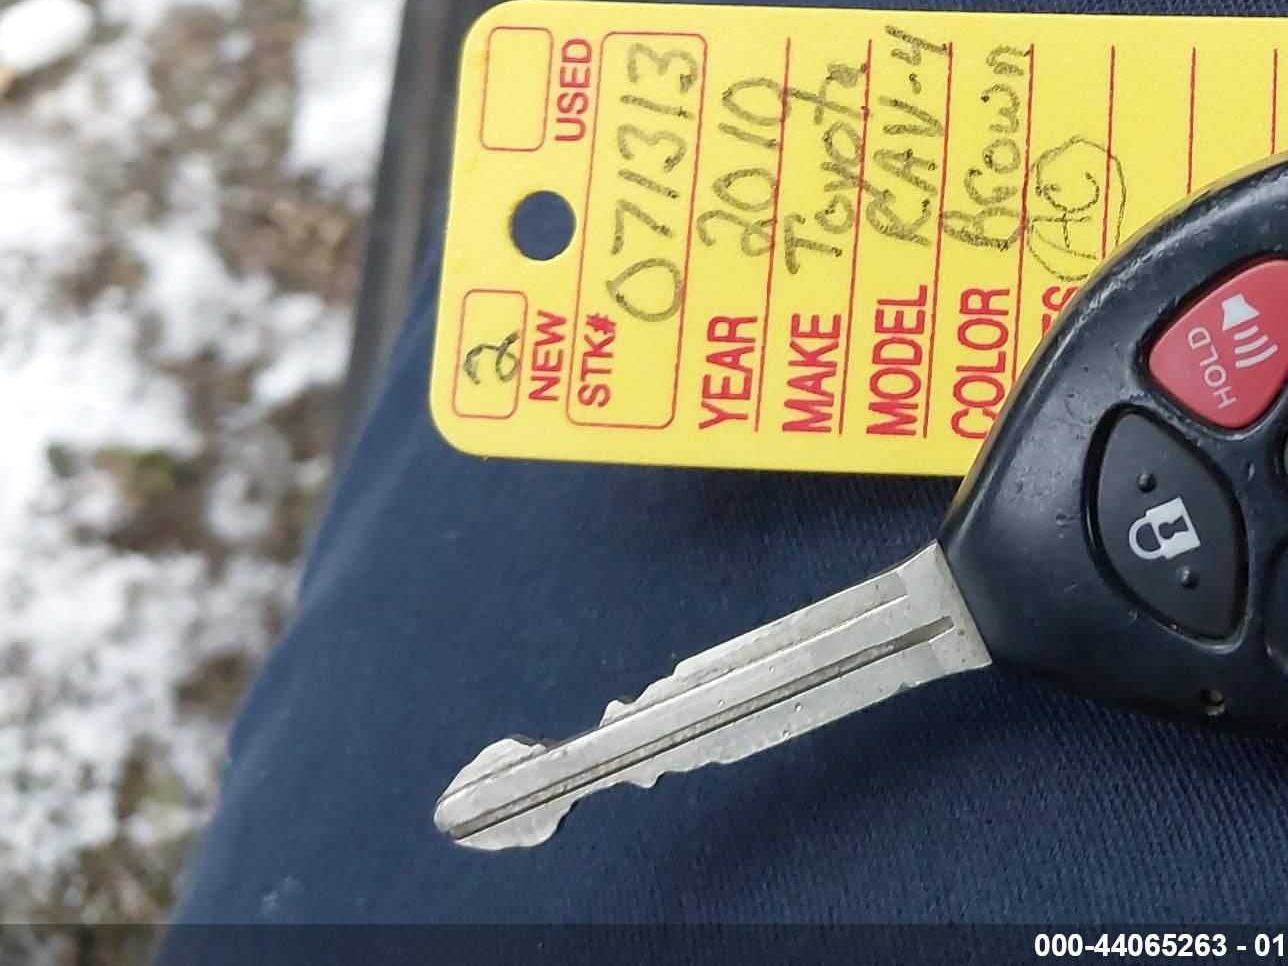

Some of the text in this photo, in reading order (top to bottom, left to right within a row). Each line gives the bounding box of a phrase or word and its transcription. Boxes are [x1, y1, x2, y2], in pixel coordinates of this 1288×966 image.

[555, 38, 593, 141] USED
[941, 44, 1033, 251] Brown
[606, 42, 699, 322] 071313
[697, 77, 791, 257] 2010
[463, 329, 520, 385] 2
[529, 310, 568, 401] NEW
[579, 313, 617, 407] STK#
[700, 316, 758, 430] YEAR
[783, 314, 842, 434] MAKE
[866, 284, 928, 436] MODEL
[950, 287, 1011, 440] COLOR
[1185, 326, 1237, 410] HOLD
